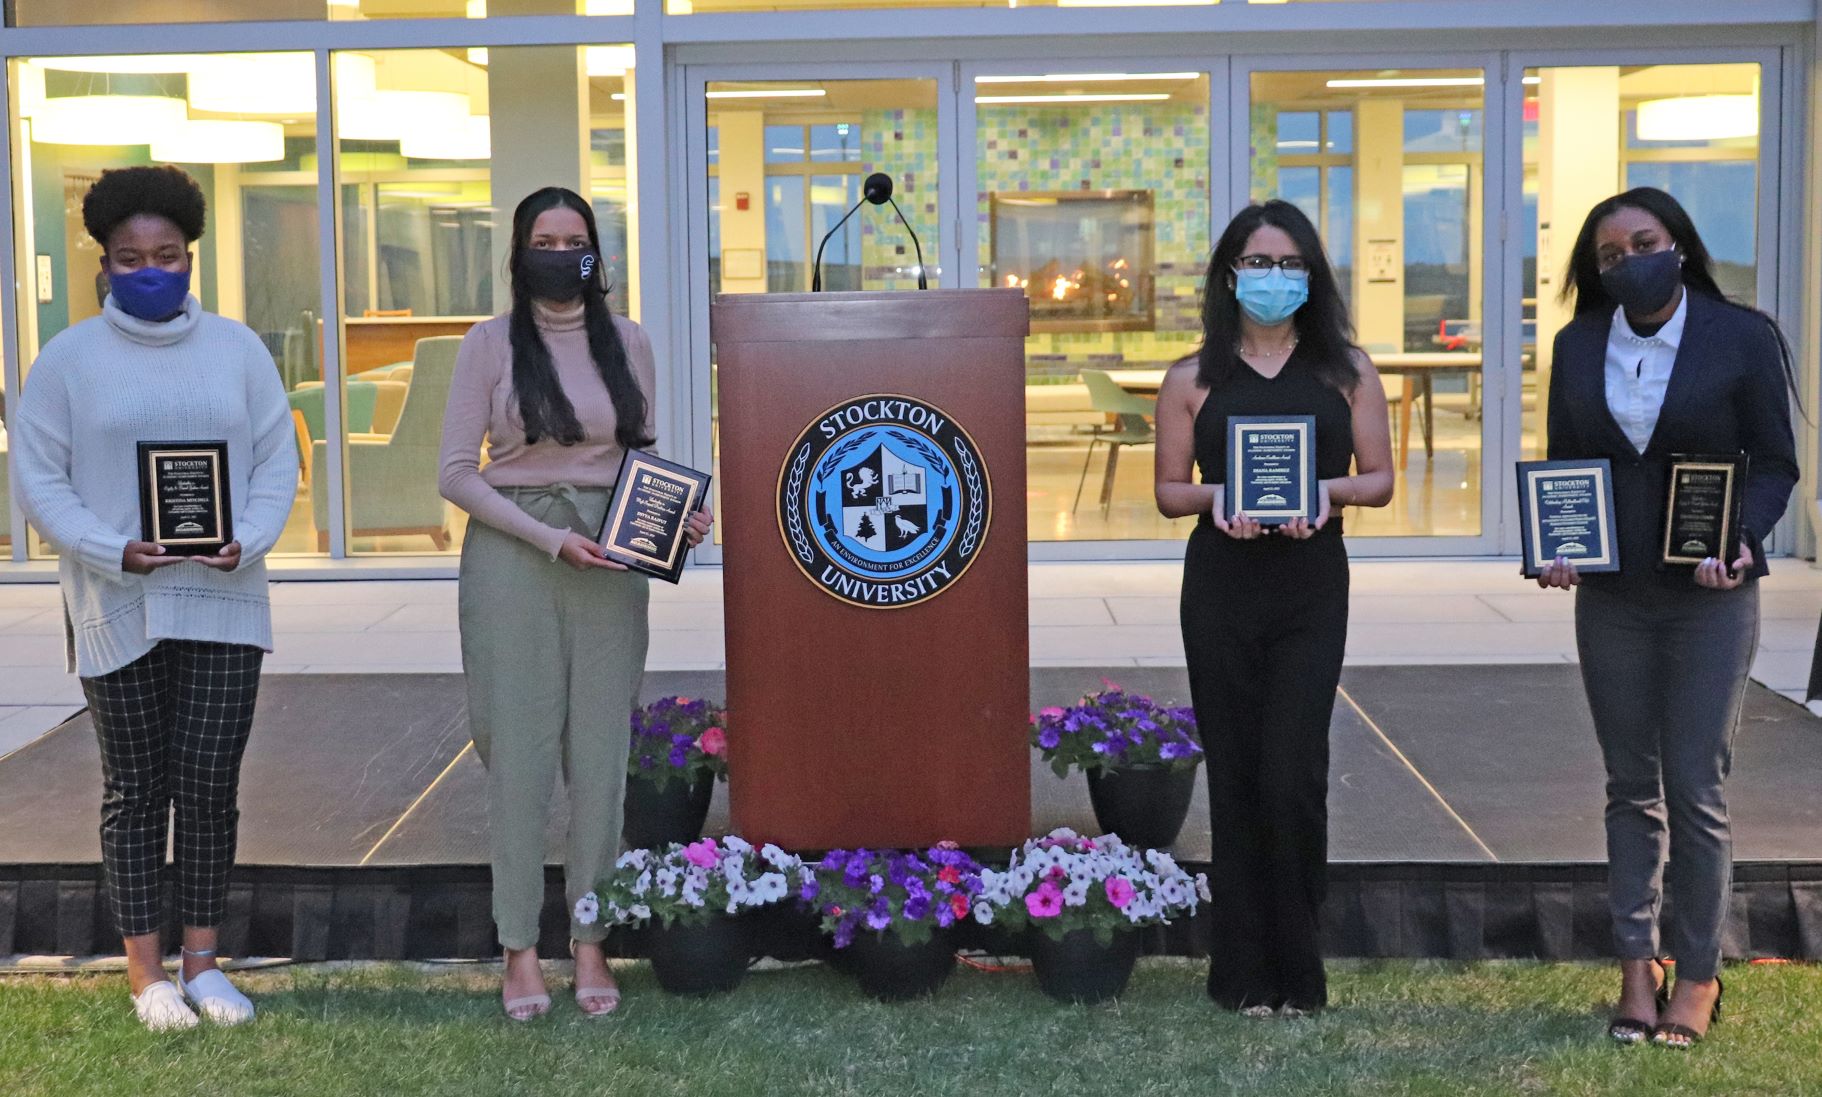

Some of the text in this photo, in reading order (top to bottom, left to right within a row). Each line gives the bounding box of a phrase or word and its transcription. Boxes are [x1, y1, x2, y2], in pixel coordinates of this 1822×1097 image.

[819, 400, 945, 440] STOCKTON
[652, 477, 684, 492] STOCKTON
[1554, 479, 1590, 487] STOCKTON
[831, 536, 940, 571] AN ENVIRONMENT FOR EXCELLENCE
[820, 560, 952, 603] UNIVERSITY
